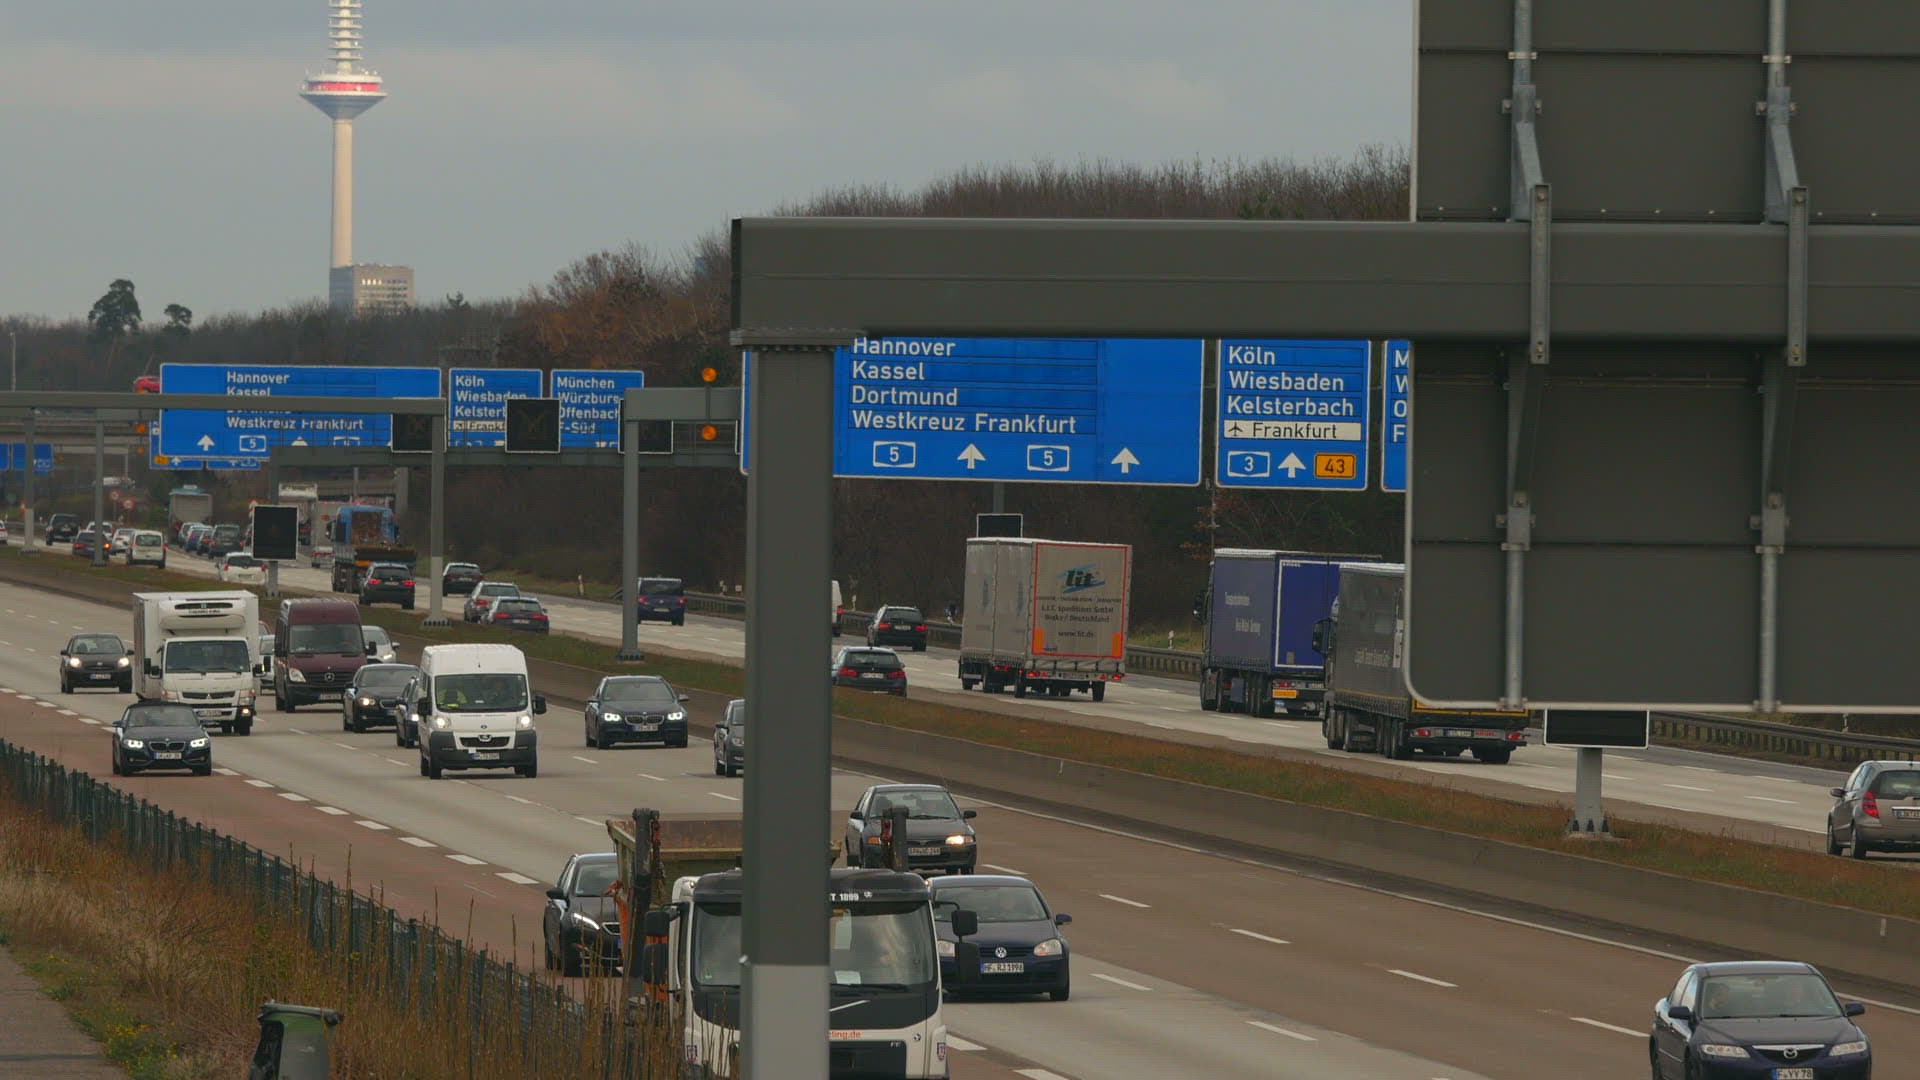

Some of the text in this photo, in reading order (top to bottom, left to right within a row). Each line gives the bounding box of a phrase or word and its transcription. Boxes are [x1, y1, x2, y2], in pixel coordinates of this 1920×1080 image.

[853, 337, 956, 357] Hannover
[1228, 346, 1275, 365] Köln
[1394, 349, 1409, 368] M
[226, 370, 290, 384] Hannover
[852, 360, 924, 380] Kassel
[455, 375, 485, 387] Köln
[557, 376, 615, 389] München
[1229, 370, 1344, 391] Wiesbaden
[852, 385, 958, 406] Dortmund
[1227, 395, 1354, 416] Kelsterbach
[1393, 399, 1407, 418] O
[226, 416, 364, 431] Westkreuz Frankfurt
[852, 410, 1076, 434] Westkreuz Frankfurt
[1252, 422, 1337, 439] Frankfurt
[249, 438, 257, 450] 5
[889, 446, 1053, 466] 5 5
[1244, 456, 1345, 474] 3 43
